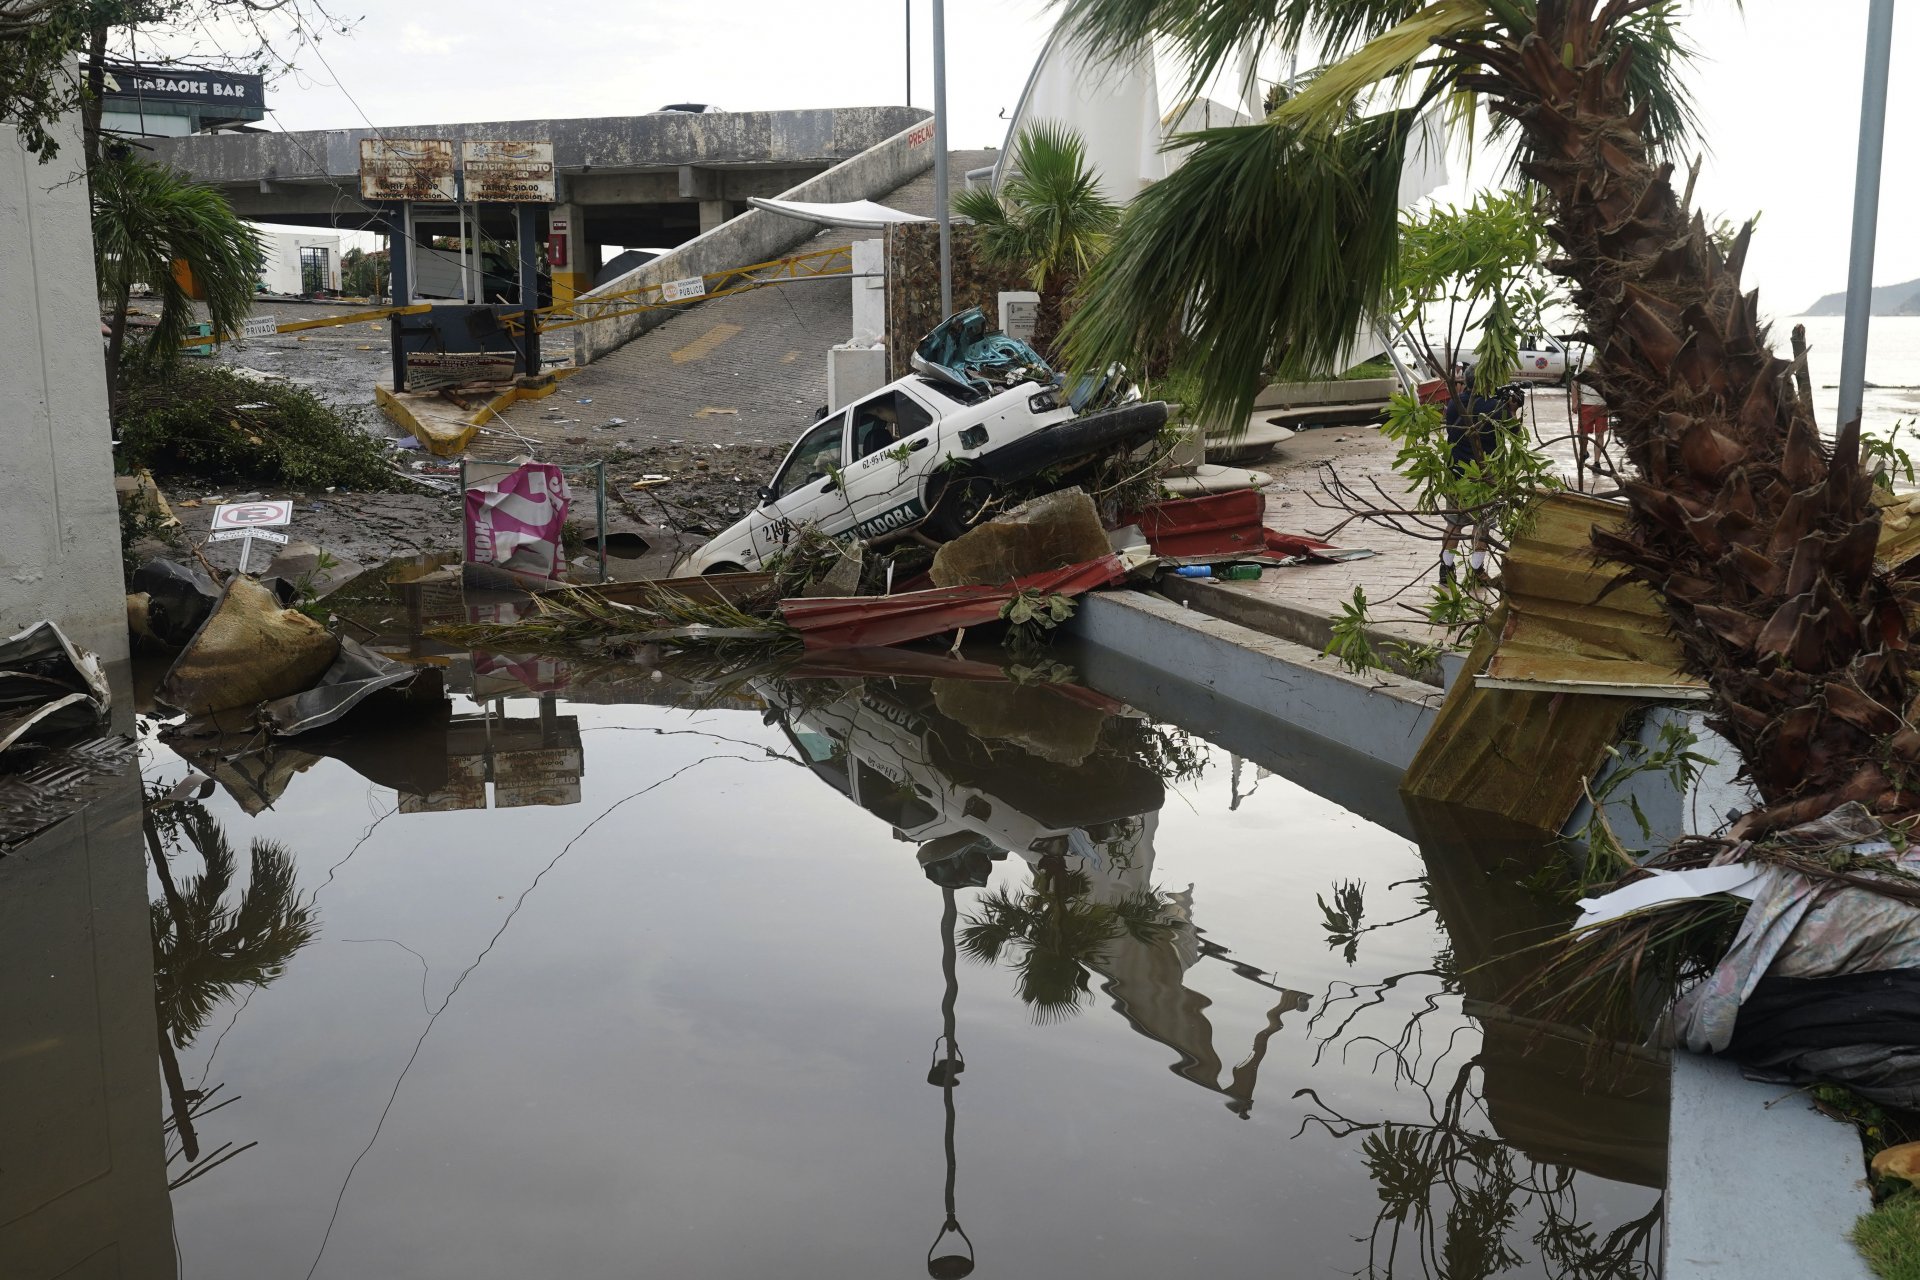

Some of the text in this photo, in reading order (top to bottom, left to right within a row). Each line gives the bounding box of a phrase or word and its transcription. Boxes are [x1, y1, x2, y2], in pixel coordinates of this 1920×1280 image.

[134, 77, 245, 98] KARAOKE BAR
[513, 184, 539, 192] $10.00
[246, 324, 276, 336] PRIVADO
[862, 448, 894, 470] 62-95-FL
